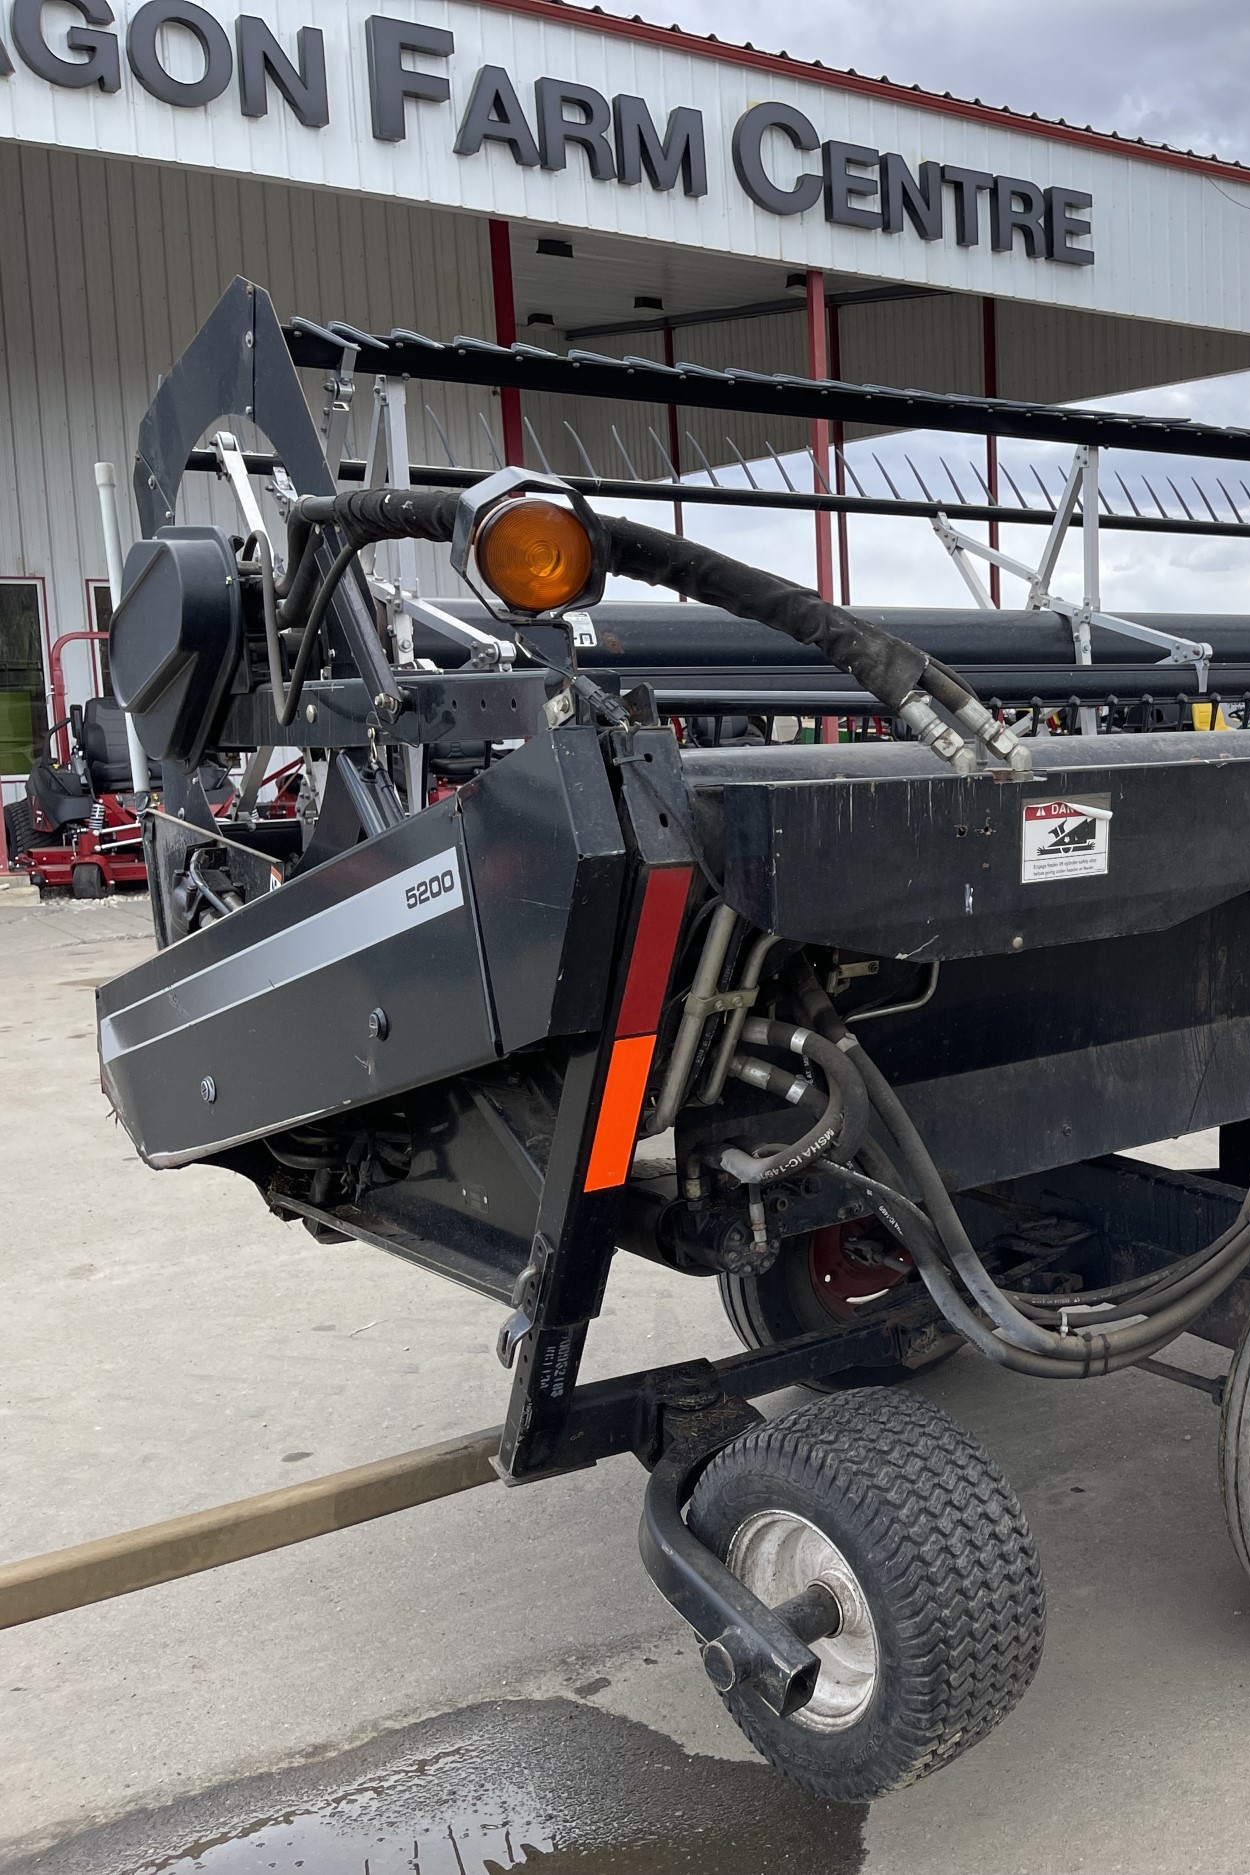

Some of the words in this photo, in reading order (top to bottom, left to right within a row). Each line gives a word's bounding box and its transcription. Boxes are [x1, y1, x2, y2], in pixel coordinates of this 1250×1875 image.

[0, 0, 330, 129] GON
[364, 14, 706, 198] FARM
[732, 101, 1095, 267] CENTRE
[1051, 803, 1075, 815] DAN
[405, 869, 455, 910] 5200
[802, 1128, 835, 1159] MSHA
